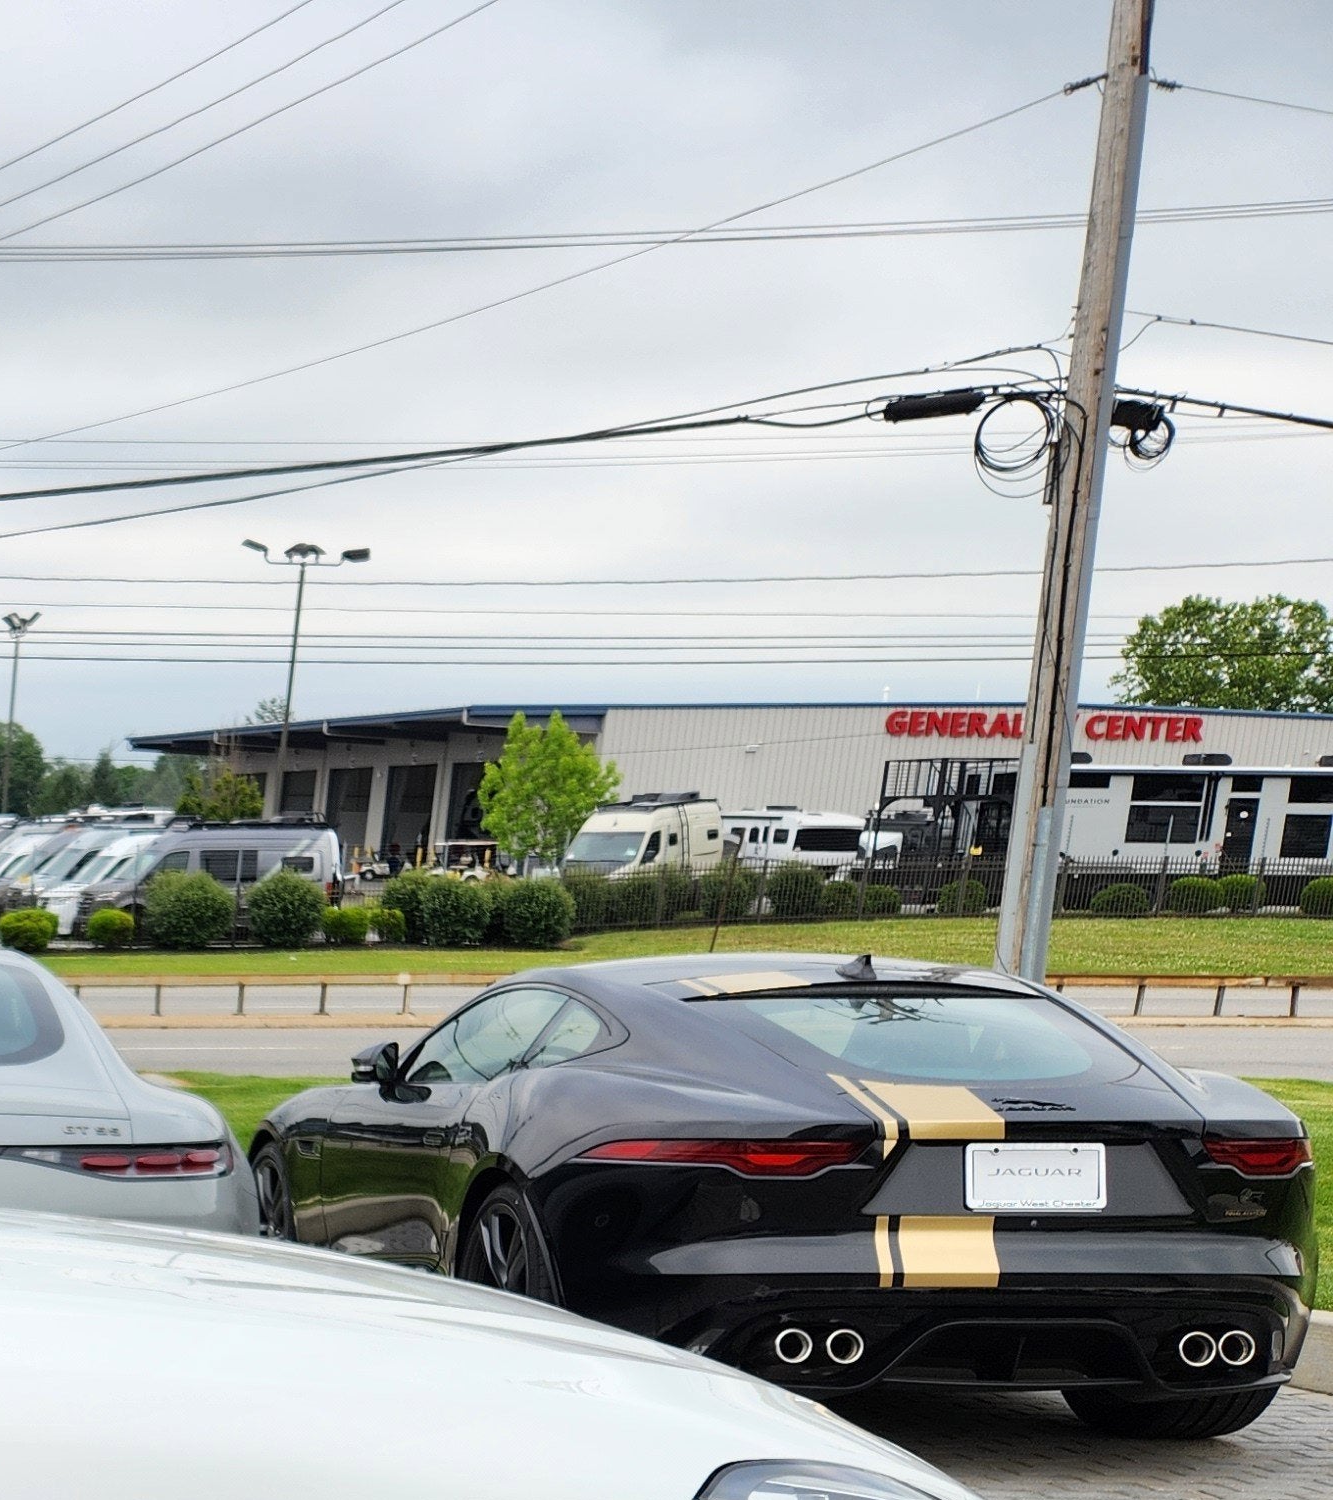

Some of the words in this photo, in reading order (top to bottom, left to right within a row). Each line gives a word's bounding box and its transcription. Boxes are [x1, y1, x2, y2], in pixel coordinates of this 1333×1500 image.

[886, 711, 1025, 739] GENERAL
[1085, 714, 1204, 743] CENTER
[987, 1168, 1082, 1177] JAGUAR
[978, 1200, 1018, 1208] Jaguar
